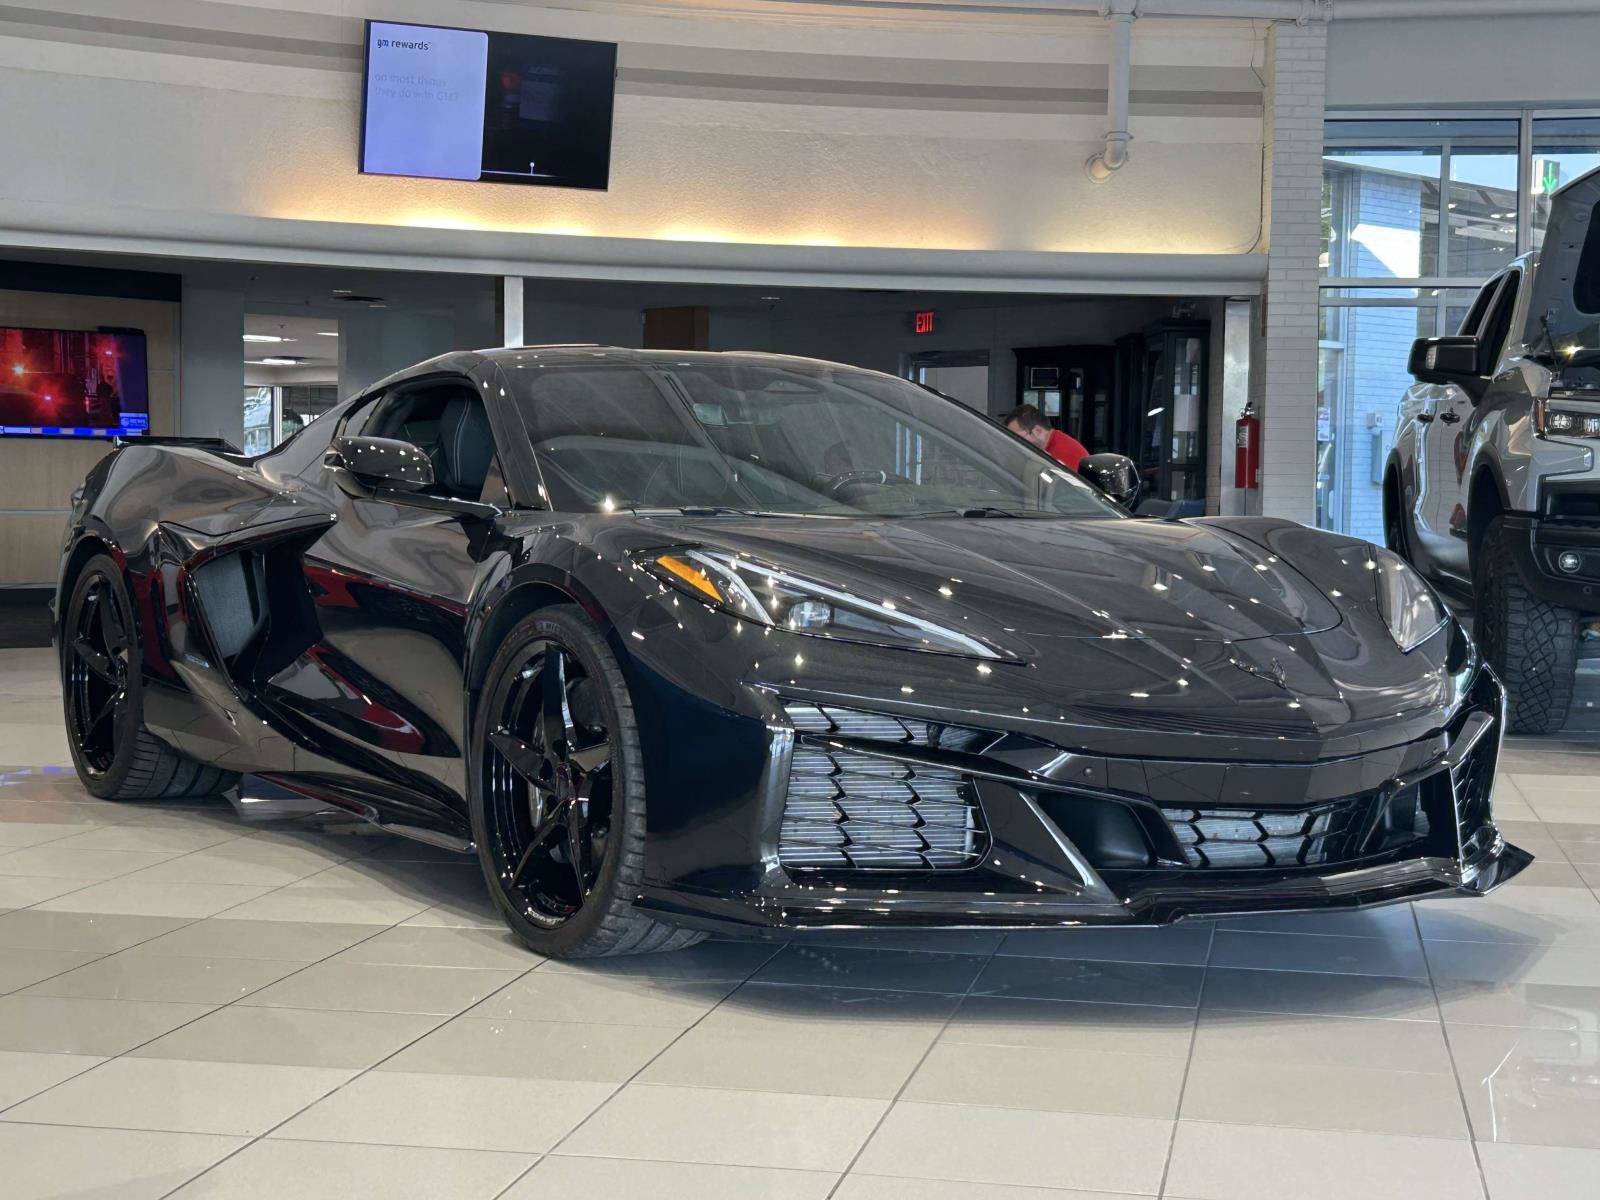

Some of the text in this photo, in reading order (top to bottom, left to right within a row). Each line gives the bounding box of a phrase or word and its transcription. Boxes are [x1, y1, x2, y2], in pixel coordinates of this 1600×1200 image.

[377, 39, 429, 50] gm rewards
[916, 312, 935, 333] EXIT
